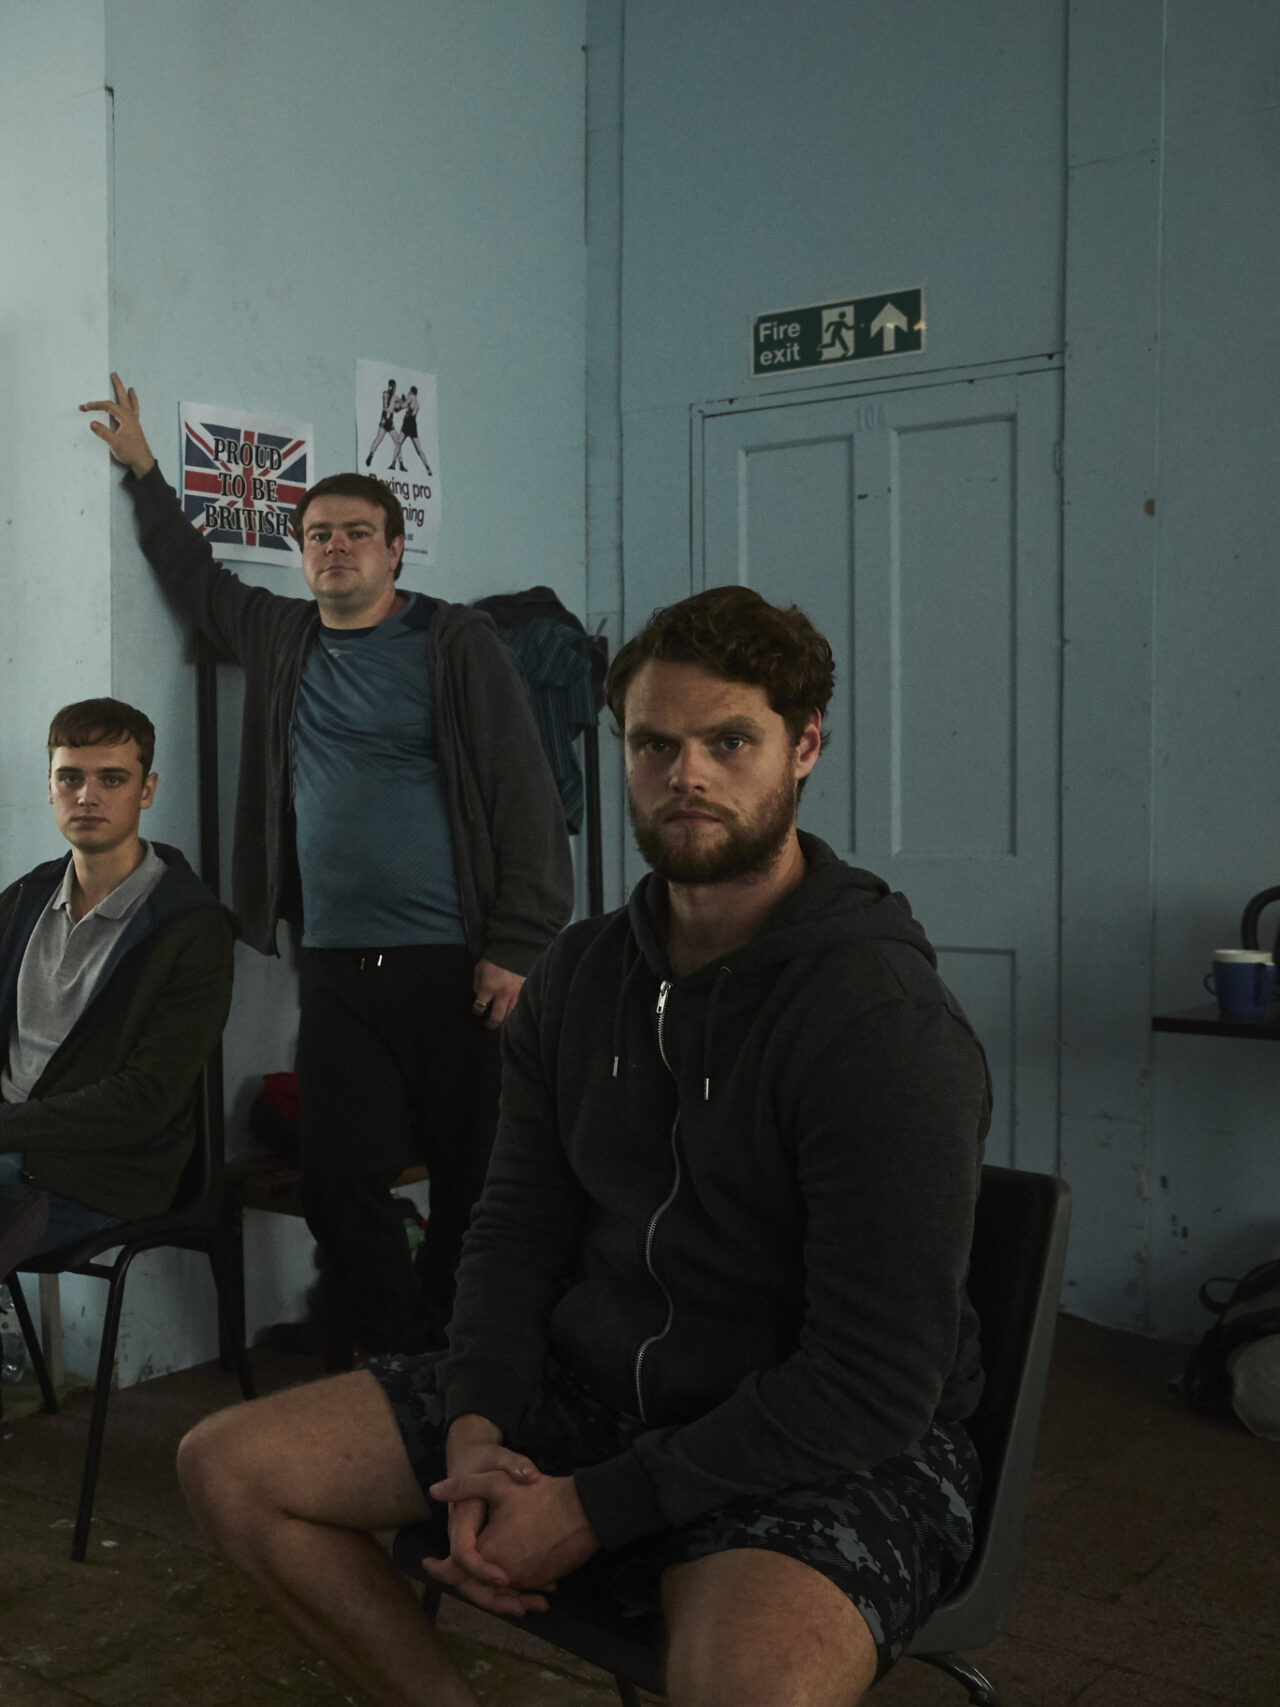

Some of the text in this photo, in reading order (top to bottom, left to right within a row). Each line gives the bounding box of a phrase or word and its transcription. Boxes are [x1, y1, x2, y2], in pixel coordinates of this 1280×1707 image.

[758, 320, 801, 343] Fire
[759, 342, 801, 366] exit
[213, 437, 282, 471] PROUD
[219, 472, 278, 503] TO BE
[412, 483, 431, 501] pro
[204, 503, 289, 537] BRITISH
